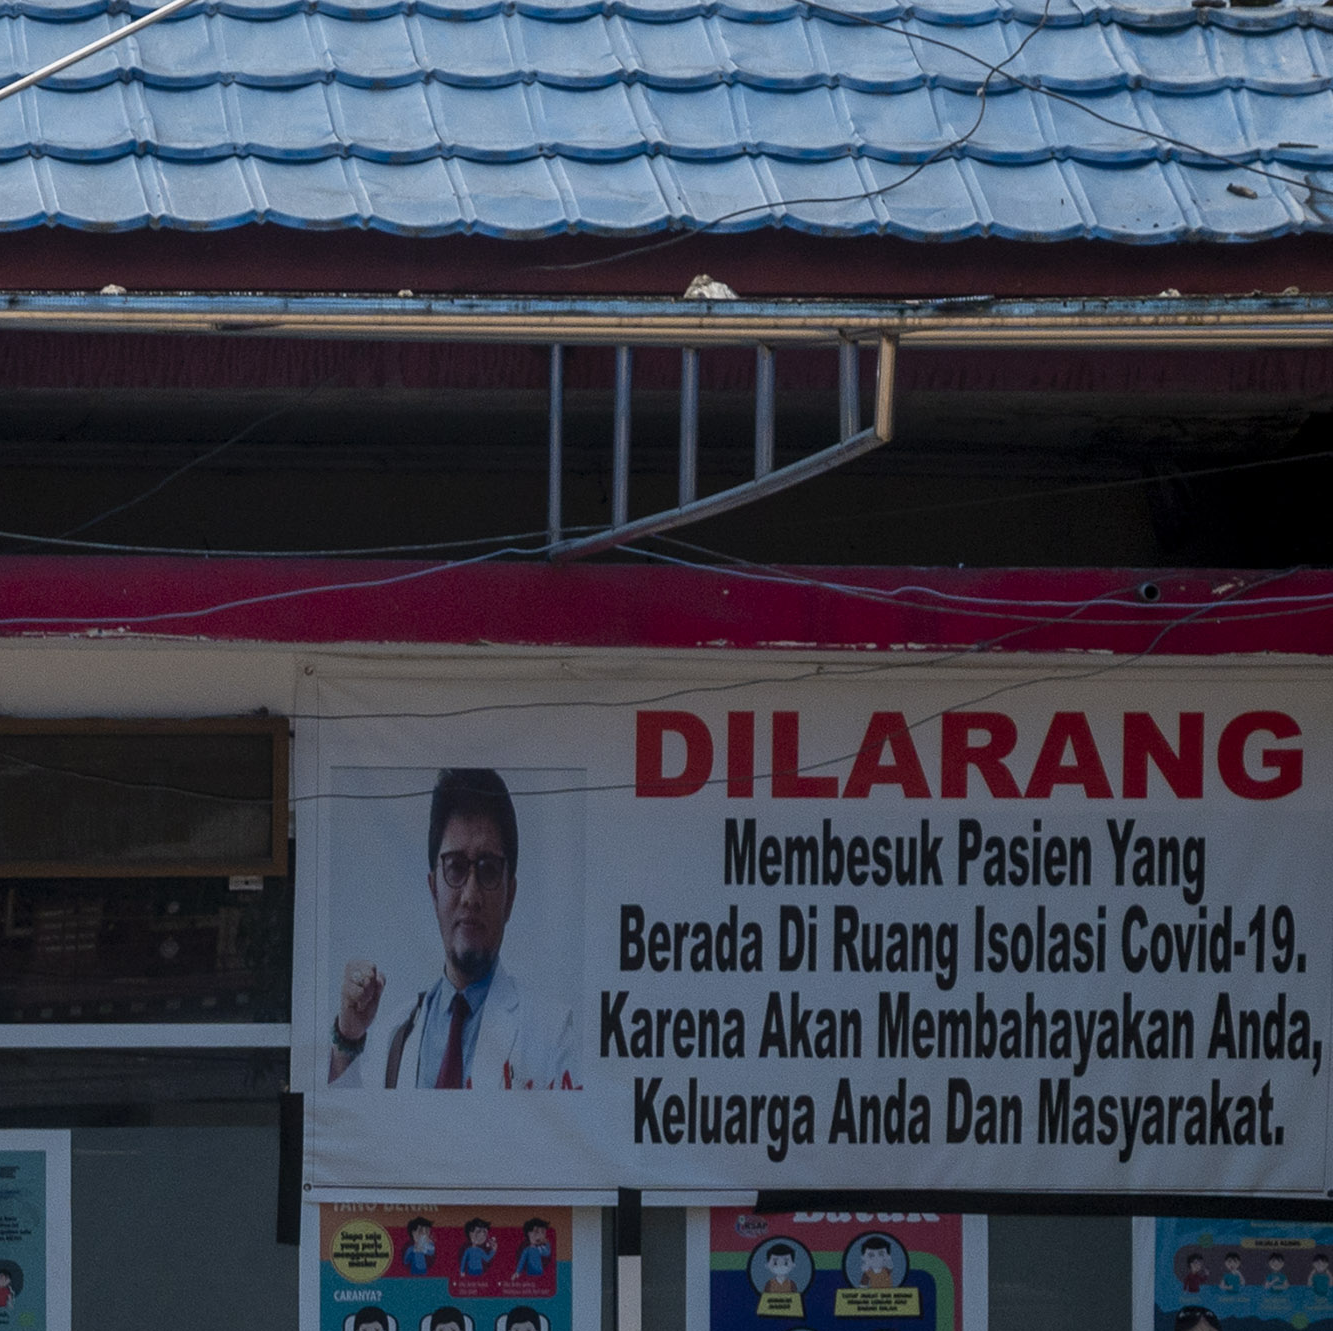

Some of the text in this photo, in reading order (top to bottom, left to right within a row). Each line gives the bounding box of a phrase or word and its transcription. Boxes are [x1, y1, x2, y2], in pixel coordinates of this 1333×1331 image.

[635, 710, 1304, 801] DILARANG
[723, 819, 1206, 905] Membesuk Pasien Yang
[618, 903, 1307, 989] Berada Di Ruang Isolasi Covid-19.
[600, 991, 1323, 1076] Karena Akan Membahayakan Anda,
[633, 1078, 1285, 1162] Keluarga Anda Dan Masyarakat.
[334, 1291, 382, 1302] CARANYA?
